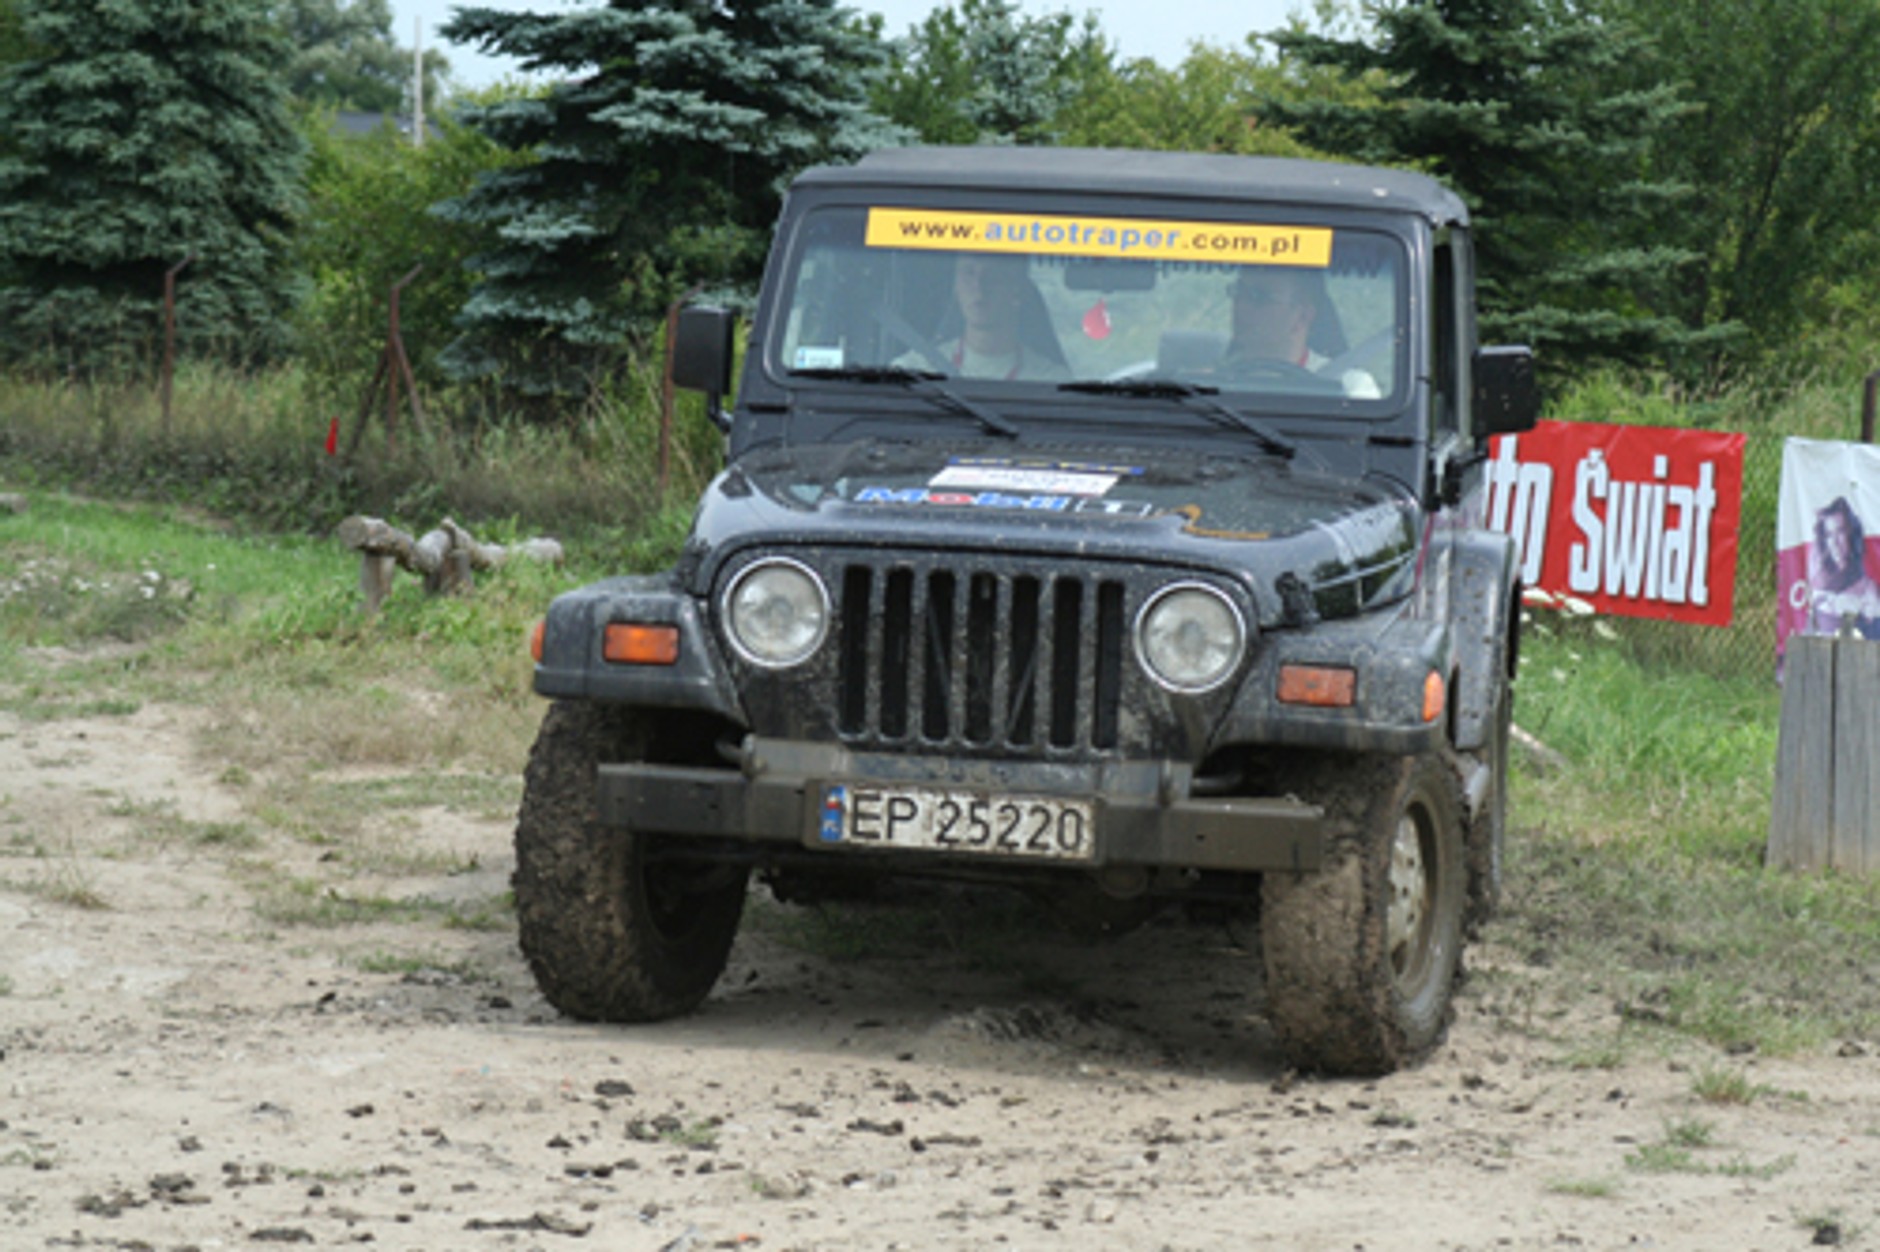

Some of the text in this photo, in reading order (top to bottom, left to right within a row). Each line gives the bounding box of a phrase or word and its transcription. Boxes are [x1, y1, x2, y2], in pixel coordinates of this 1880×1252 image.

[899, 219, 1301, 256] www.autotraper.com.pl
[1570, 447, 1716, 606] Świat
[851, 794, 1084, 851] EP 25220
